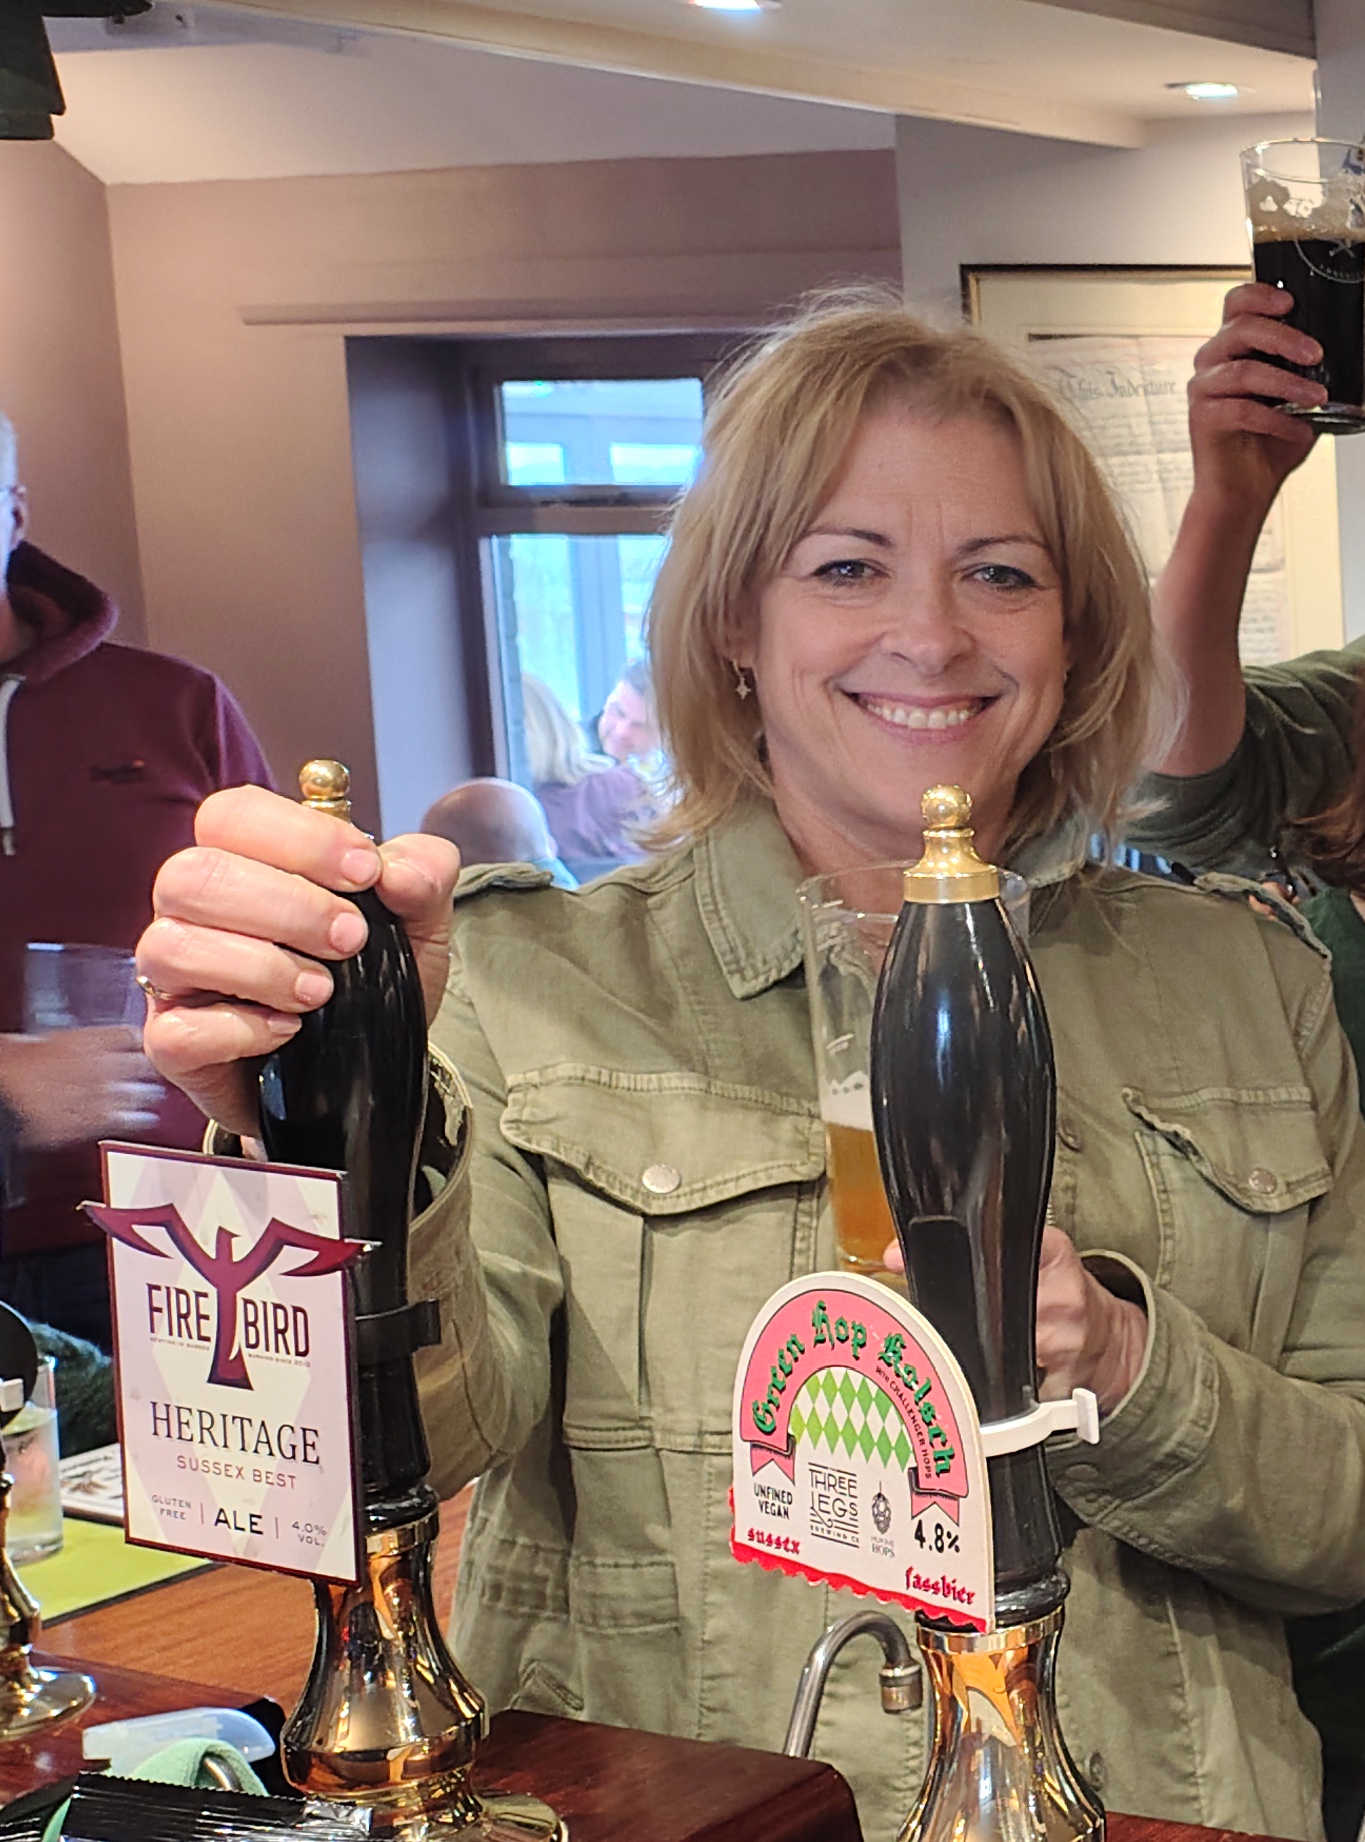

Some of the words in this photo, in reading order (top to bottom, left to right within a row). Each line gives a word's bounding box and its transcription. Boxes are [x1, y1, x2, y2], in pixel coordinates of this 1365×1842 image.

[146, 1283, 212, 1342] FIRE
[241, 1297, 310, 1357] BIRD
[752, 1334, 806, 1434] Green
[150, 1401, 321, 1465] HERITAGE
[875, 1365, 890, 1383] WITH
[889, 1380, 927, 1447] CHALLENGER
[921, 1448, 932, 1479] HOPS
[176, 1455, 245, 1480] SUSSEX
[252, 1469, 297, 1489] BEST
[808, 1468, 858, 1499] THREE
[151, 1494, 192, 1509] GLUTEN
[754, 1483, 793, 1506] UNFINED
[758, 1500, 790, 1520] VEGAN
[810, 1490, 859, 1521] LEGS
[159, 1508, 187, 1520] FREE
[214, 1507, 264, 1535] ALE
[291, 1521, 327, 1537] 4.0%
[872, 1543, 896, 1558] HOPS
[914, 1519, 960, 1553] 4.8%
[905, 1565, 976, 1606] fassbier
